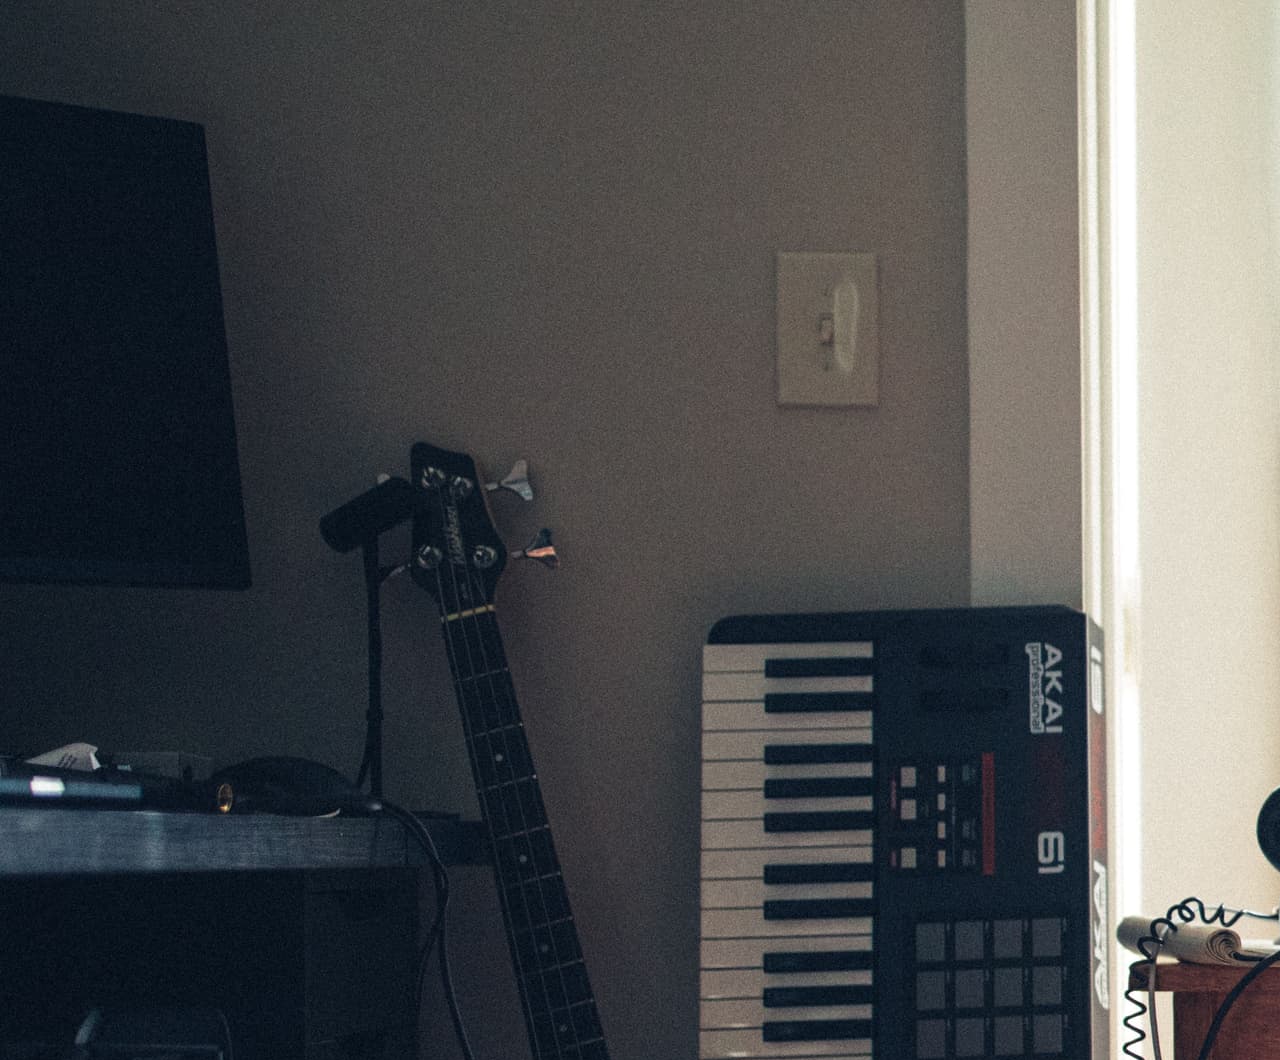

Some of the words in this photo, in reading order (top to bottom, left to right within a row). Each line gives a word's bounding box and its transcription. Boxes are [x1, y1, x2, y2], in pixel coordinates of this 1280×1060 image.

[1026, 643, 1043, 733] professional
[1044, 643, 1063, 733] AKAI
[1037, 831, 1065, 874] 61
